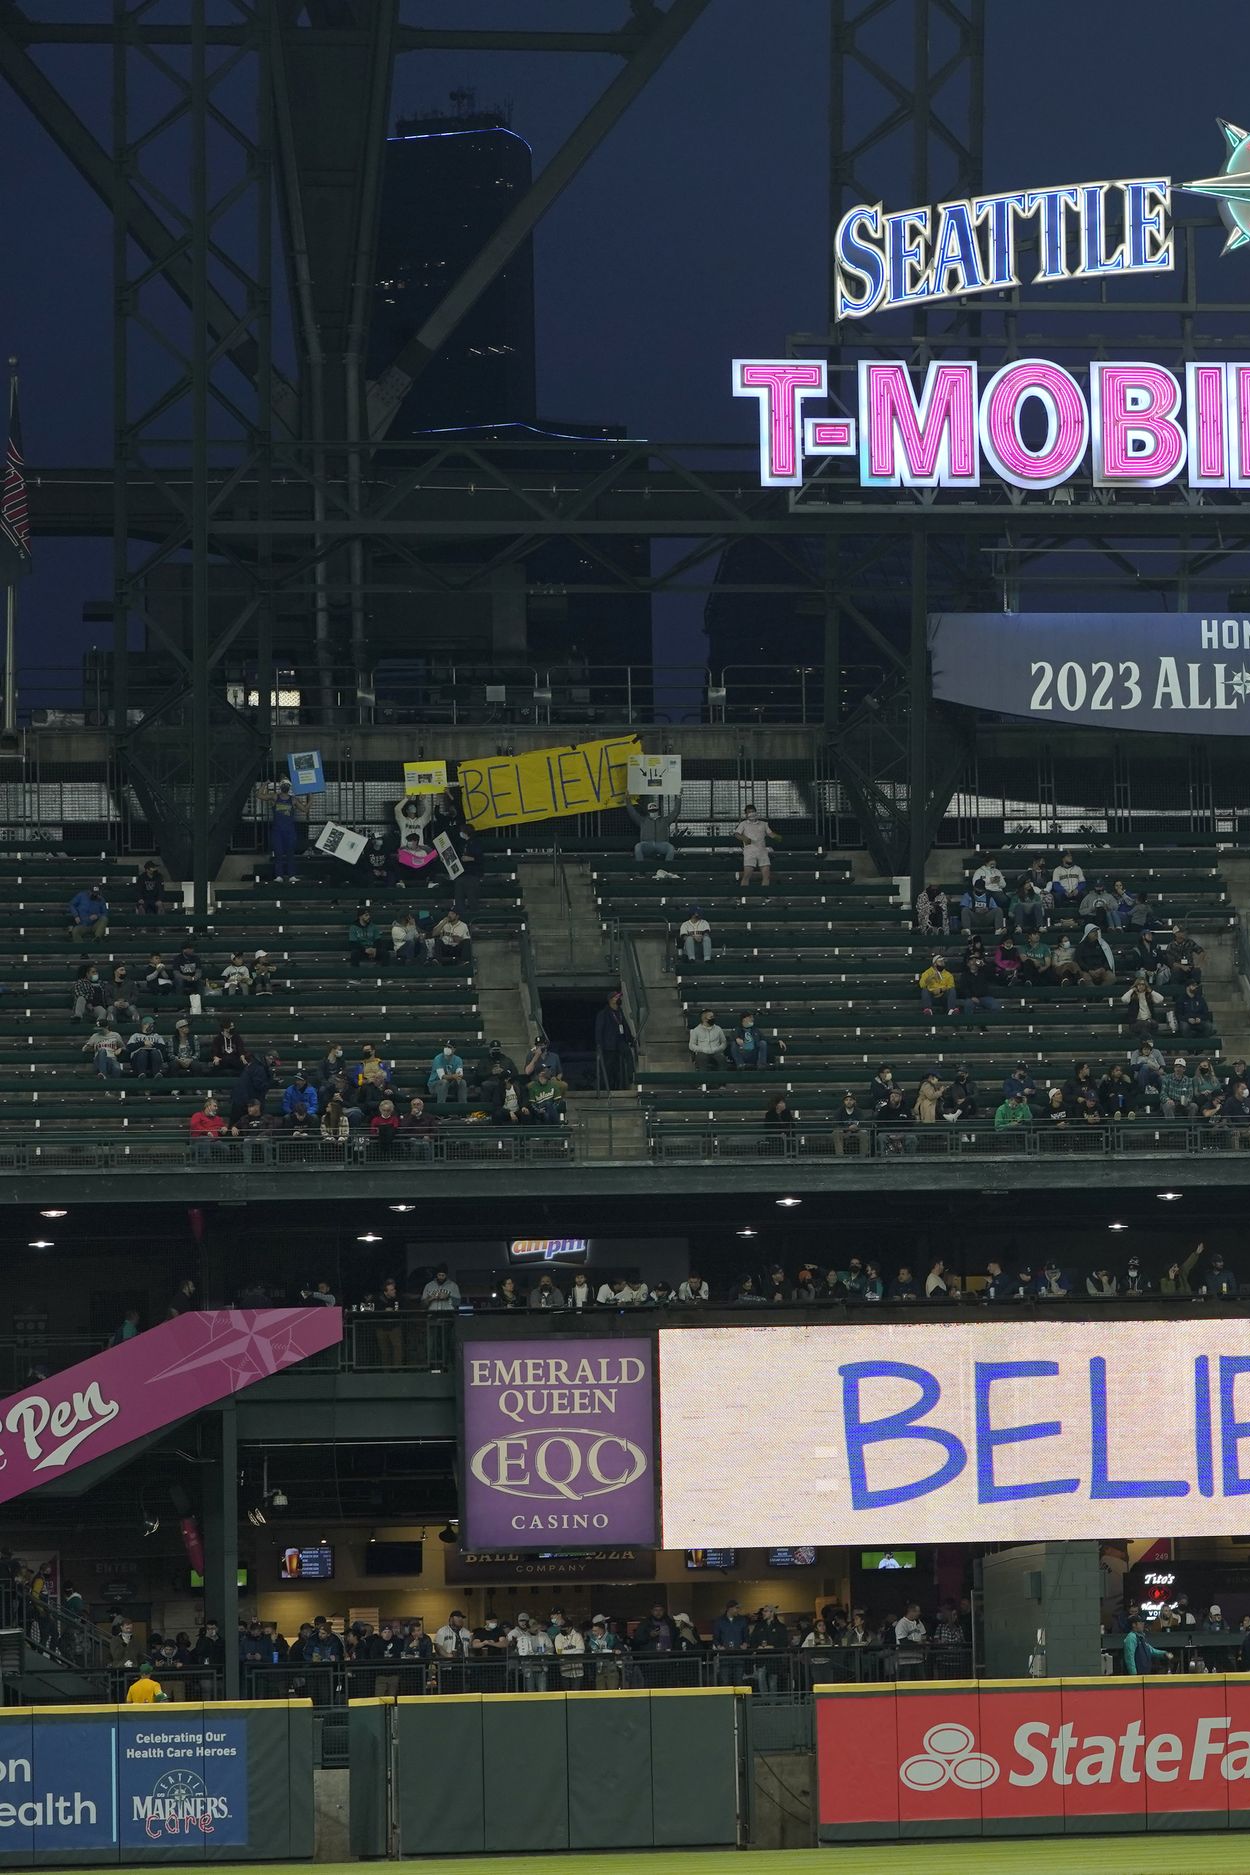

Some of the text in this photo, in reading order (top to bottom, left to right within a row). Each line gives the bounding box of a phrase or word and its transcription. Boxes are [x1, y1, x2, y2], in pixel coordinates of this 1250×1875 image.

[833, 174, 1174, 322] SEATTLE
[1029, 661, 1144, 712] 2023
[459, 741, 630, 821] BELIEVE
[469, 1355, 646, 1388] EMERALD
[498, 1388, 618, 1423] QUEEN
[6, 1381, 119, 1461] Pen
[490, 1435, 630, 1501] EQC
[511, 1513, 609, 1530] CASINO
[515, 1564, 587, 1574] COMPANY
[1144, 1572, 1176, 1585] Tito's
[136, 1731, 226, 1744] Celebrating Our
[126, 1746, 237, 1759] Health Care Heroes
[157, 1773, 204, 1798] SEATTLE
[132, 1795, 229, 1821] MARINERS
